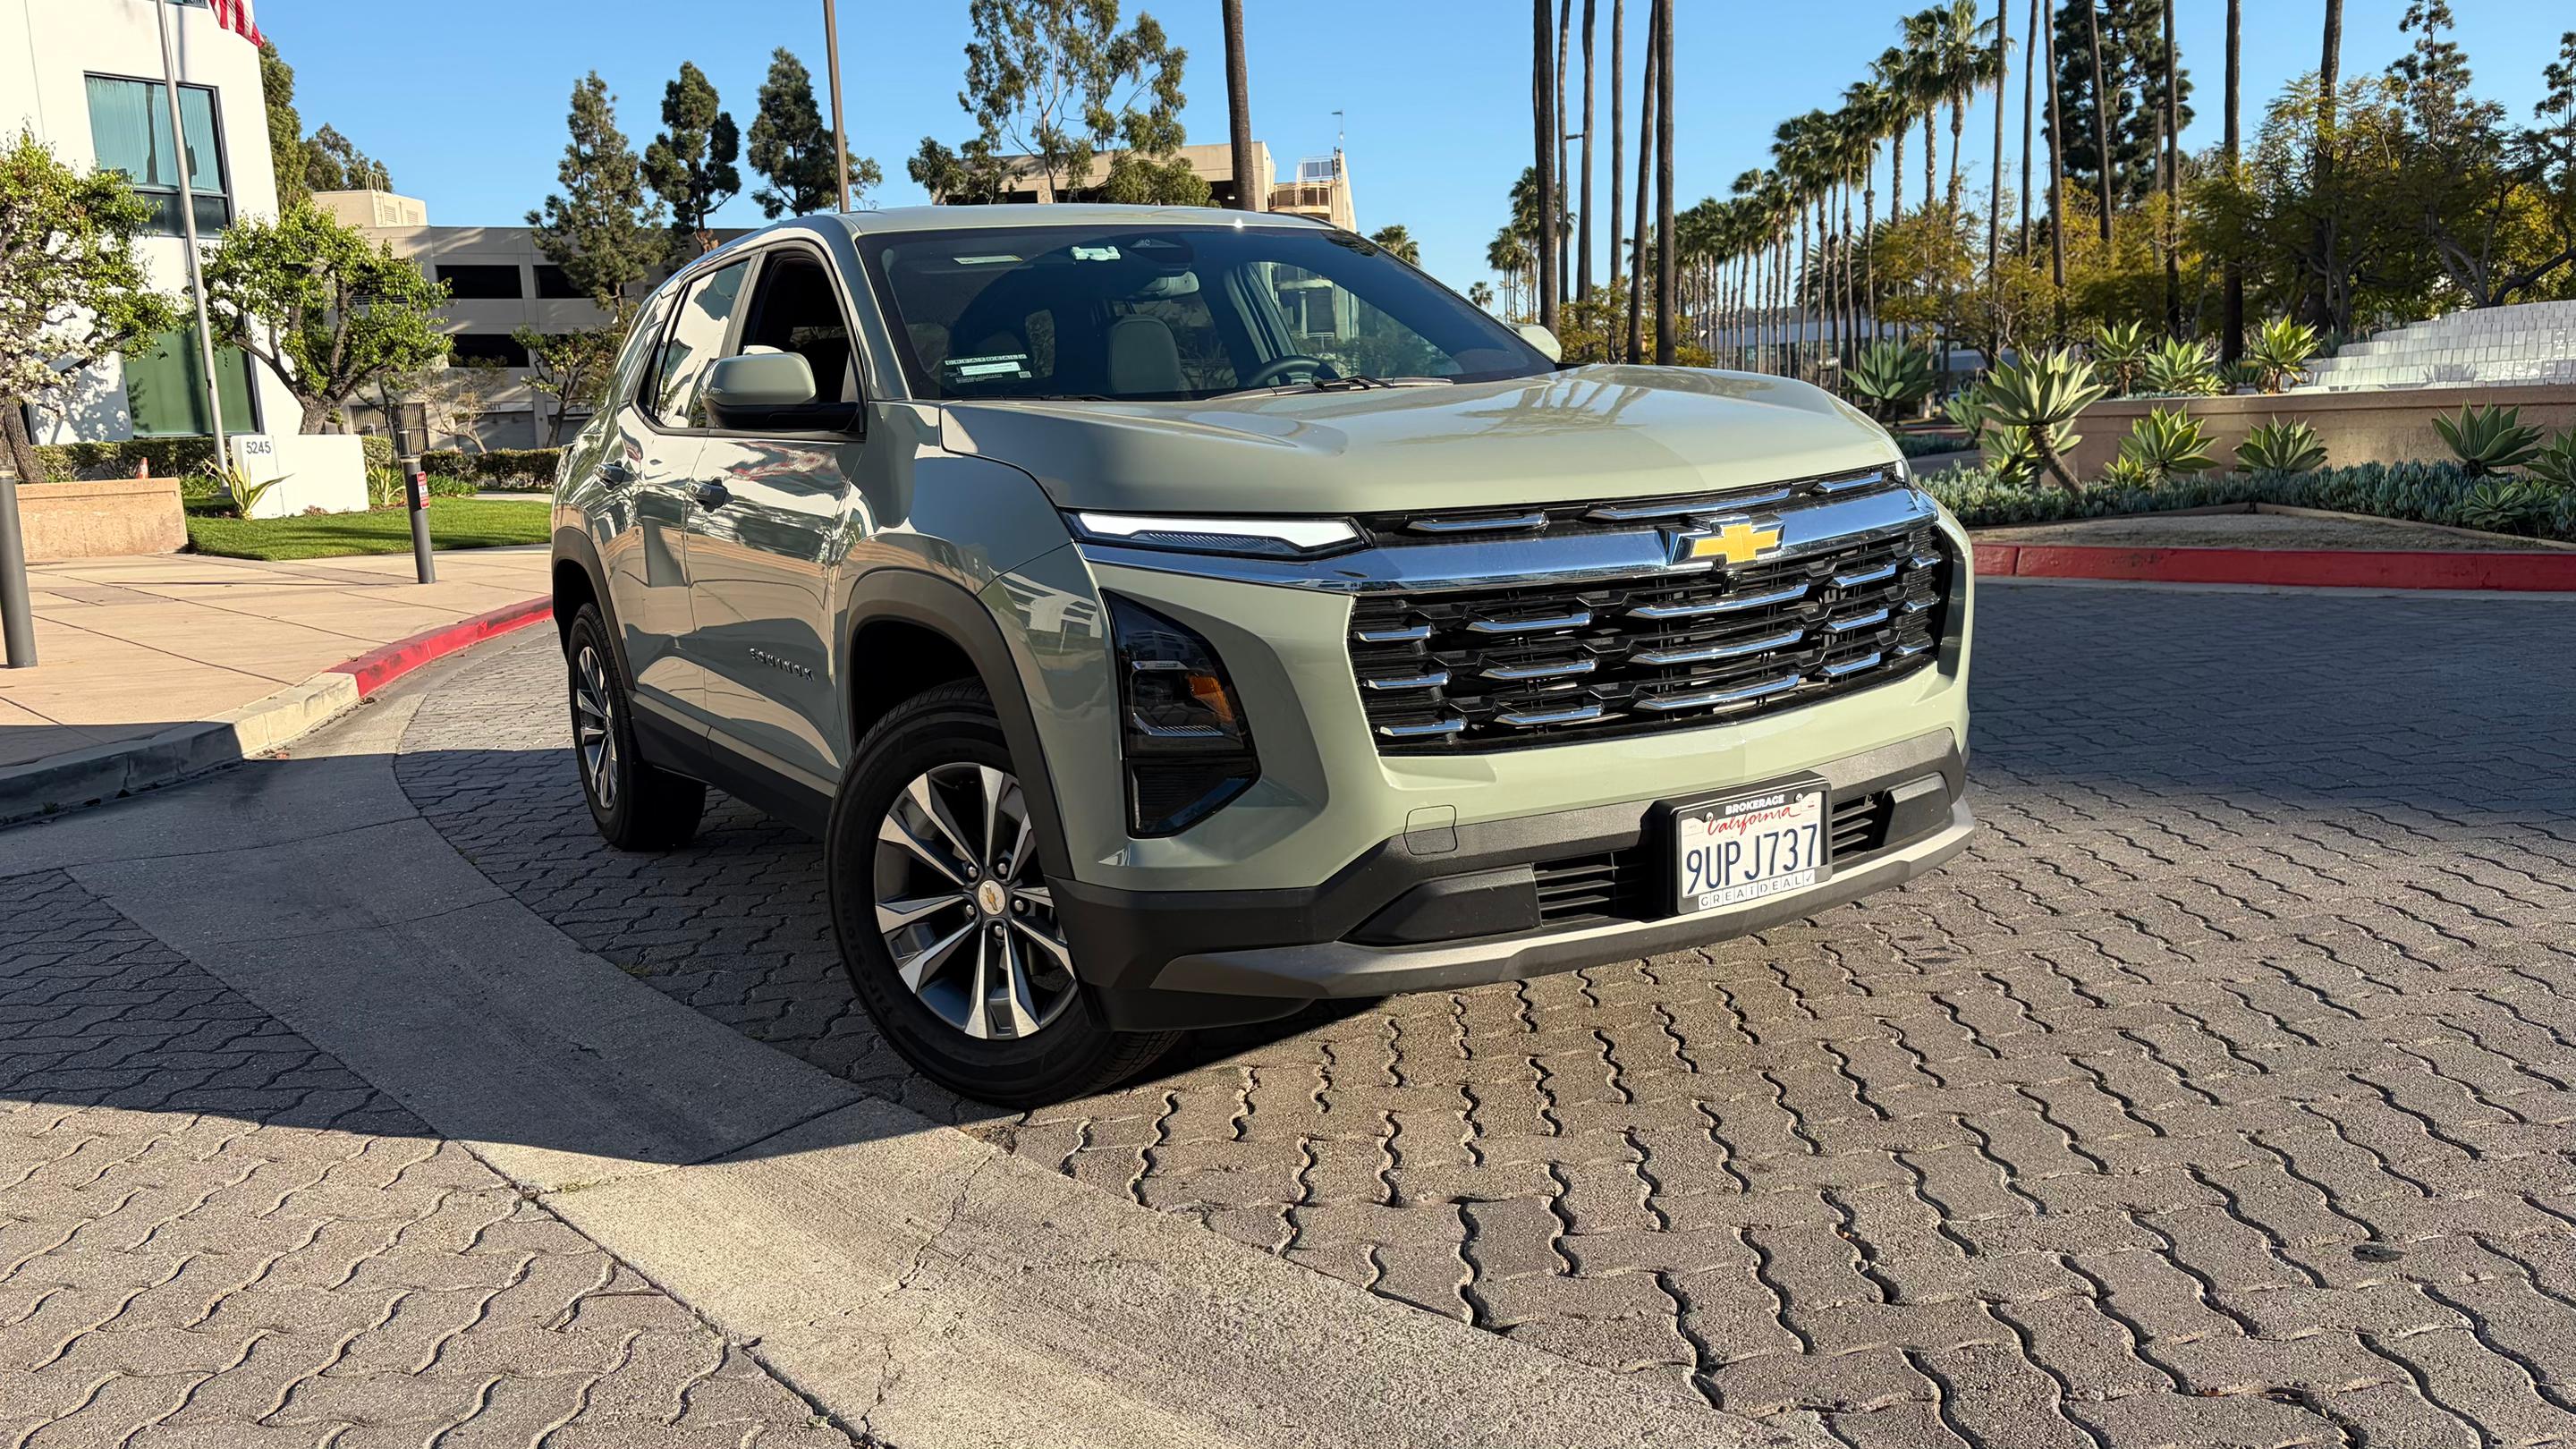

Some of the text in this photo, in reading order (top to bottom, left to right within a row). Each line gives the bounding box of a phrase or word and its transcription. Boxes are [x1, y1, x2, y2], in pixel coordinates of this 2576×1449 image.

[246, 441, 271, 454] 5245
[1725, 793, 1784, 815] BROKERAGE
[1707, 806, 1801, 835] California
[1686, 823, 1818, 894] 9UPJ737
